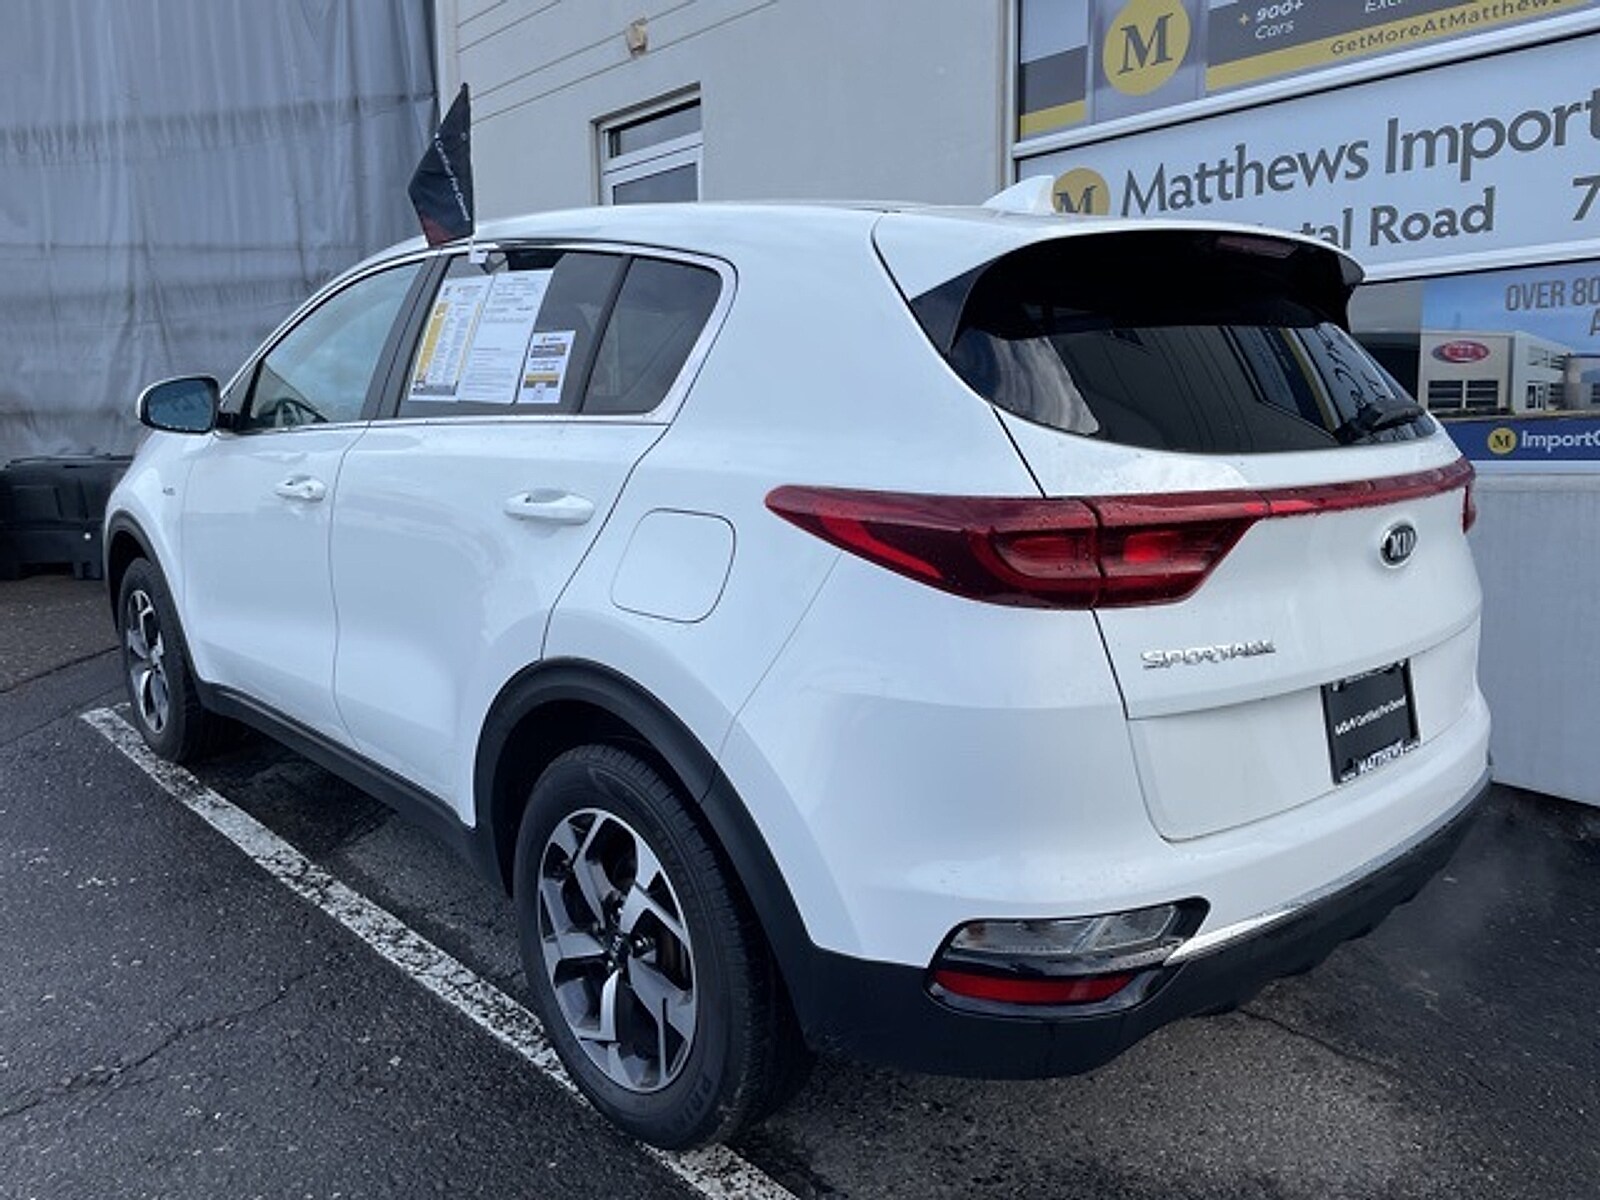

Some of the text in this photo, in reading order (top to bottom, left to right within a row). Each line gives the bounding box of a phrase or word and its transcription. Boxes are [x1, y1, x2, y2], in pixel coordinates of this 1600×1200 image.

[1117, 12, 1174, 76] M
[1255, 20, 1294, 38] Cars
[1330, 0, 1561, 55] GetMoreAtMatthew
[1120, 139, 1369, 218] Matthews
[1369, 185, 1496, 247] Road
[1504, 280, 1566, 312] OVER
